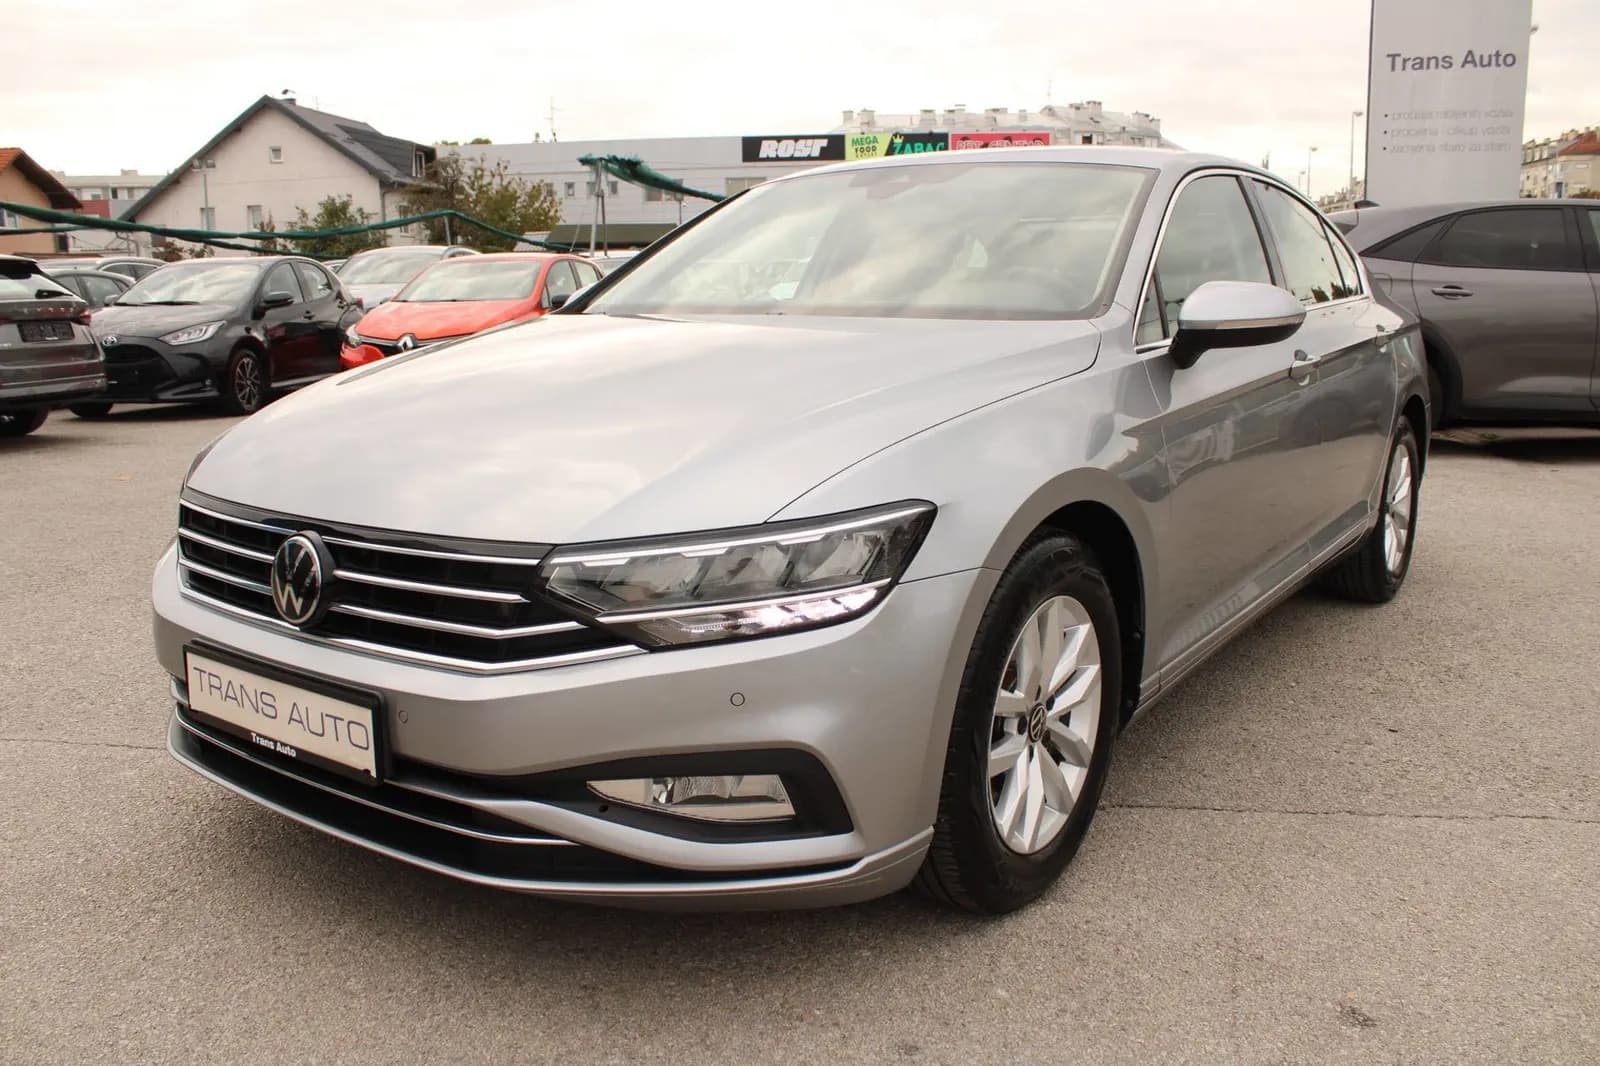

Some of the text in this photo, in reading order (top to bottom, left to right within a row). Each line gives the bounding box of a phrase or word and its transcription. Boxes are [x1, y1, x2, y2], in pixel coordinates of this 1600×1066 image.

[1386, 49, 1517, 72] Trans Auto
[851, 135, 879, 147] MEGA
[855, 145, 877, 154] FOOD
[193, 667, 370, 750] TRANS AUTO
[251, 732, 297, 758] Trans Auto
